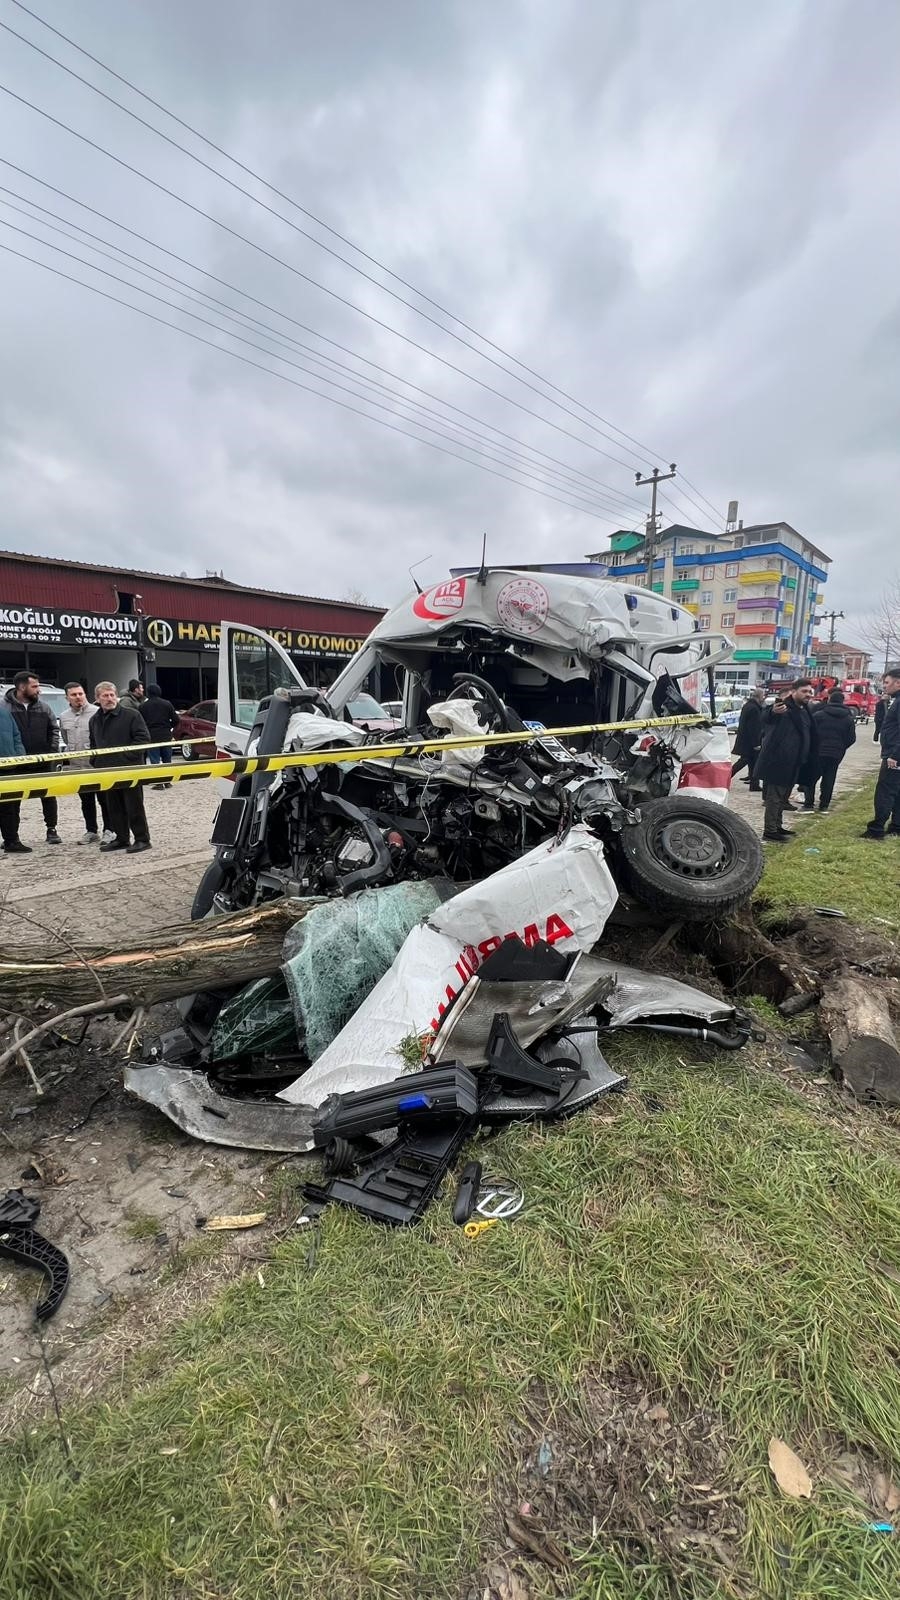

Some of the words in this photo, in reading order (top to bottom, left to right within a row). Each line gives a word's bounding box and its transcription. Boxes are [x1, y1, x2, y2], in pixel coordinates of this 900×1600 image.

[439, 582, 460, 596] 112
[60, 614, 137, 632] OTOMOTİV
[27, 627, 61, 635] AKOĞLU
[97, 632, 132, 640] AKOĞLU
